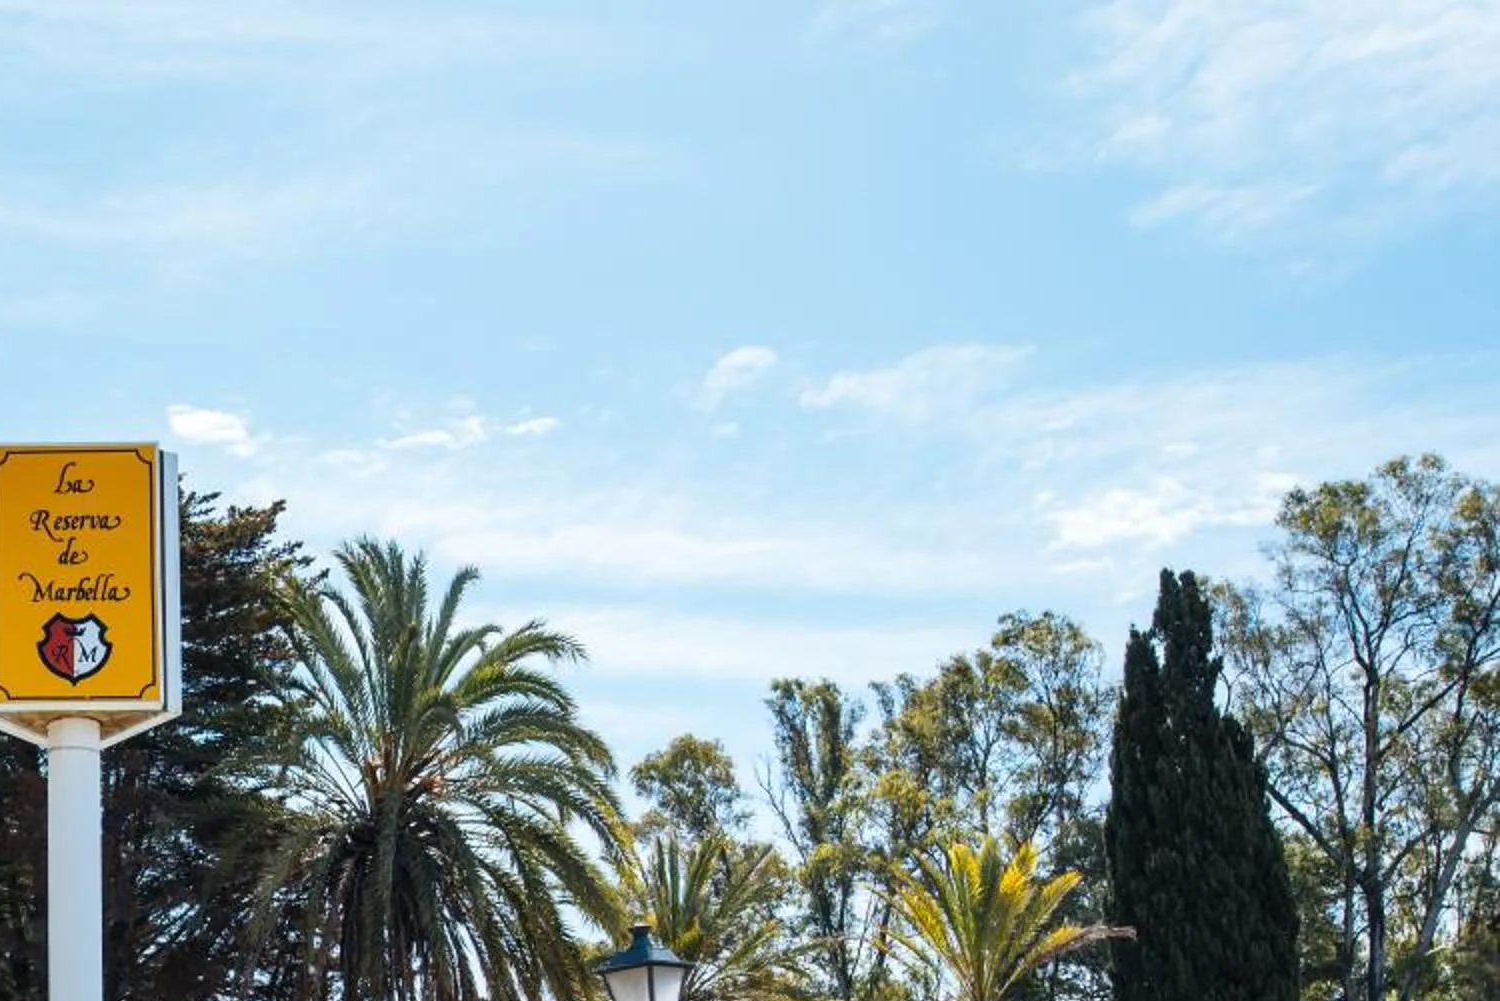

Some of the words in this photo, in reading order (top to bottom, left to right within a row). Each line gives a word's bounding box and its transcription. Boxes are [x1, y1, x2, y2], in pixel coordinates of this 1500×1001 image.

[54, 462, 94, 494] La
[29, 509, 121, 543] Reserva
[57, 537, 89, 566] de
[17, 571, 131, 603] Marbella
